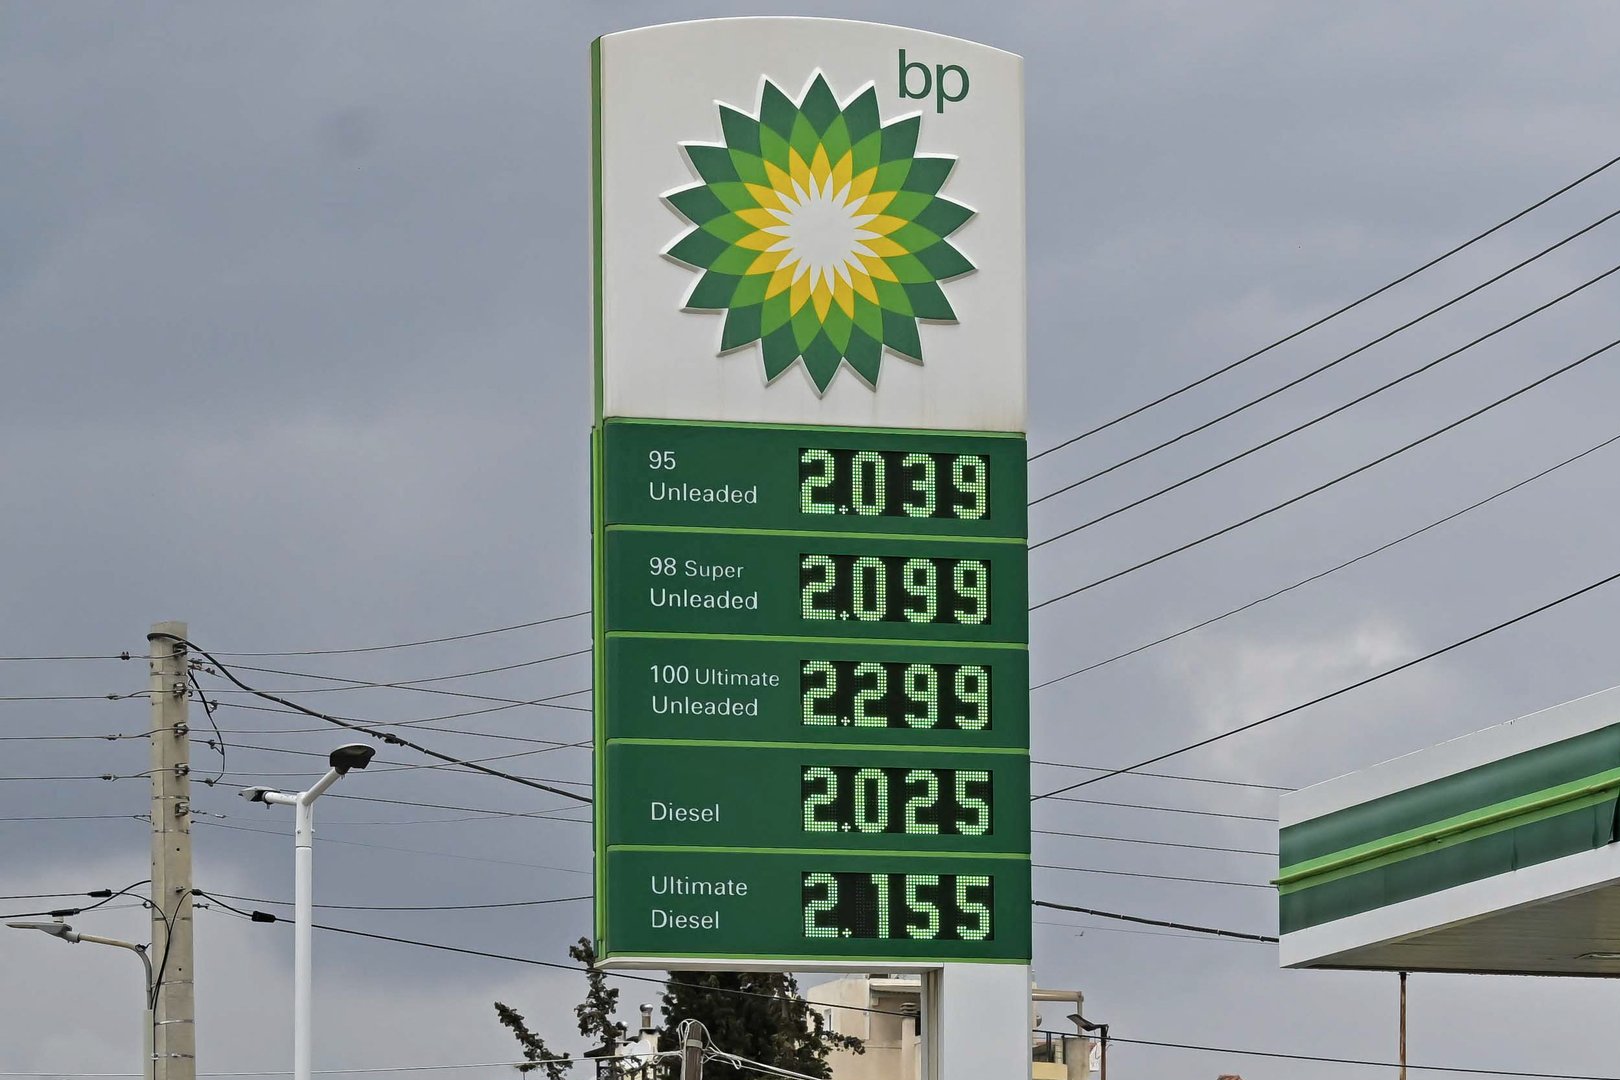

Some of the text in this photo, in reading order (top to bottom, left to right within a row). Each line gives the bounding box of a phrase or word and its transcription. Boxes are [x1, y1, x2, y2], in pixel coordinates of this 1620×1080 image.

[898, 48, 970, 114] bp
[648, 450, 677, 470] 95
[648, 482, 758, 505] Unleaded
[800, 448, 987, 520] 2.039
[649, 557, 744, 581] 98 Super
[649, 589, 759, 611] Unleaded
[801, 553, 988, 625] 2.099
[649, 665, 781, 688] 100 Ultimate
[651, 696, 759, 717] Unleaded
[802, 660, 989, 731] 2.299
[650, 802, 720, 824] Diesel
[803, 766, 990, 837] 2.025
[651, 876, 748, 897] Ultimate
[804, 872, 991, 941] 2.155
[651, 909, 720, 930] Diesel
